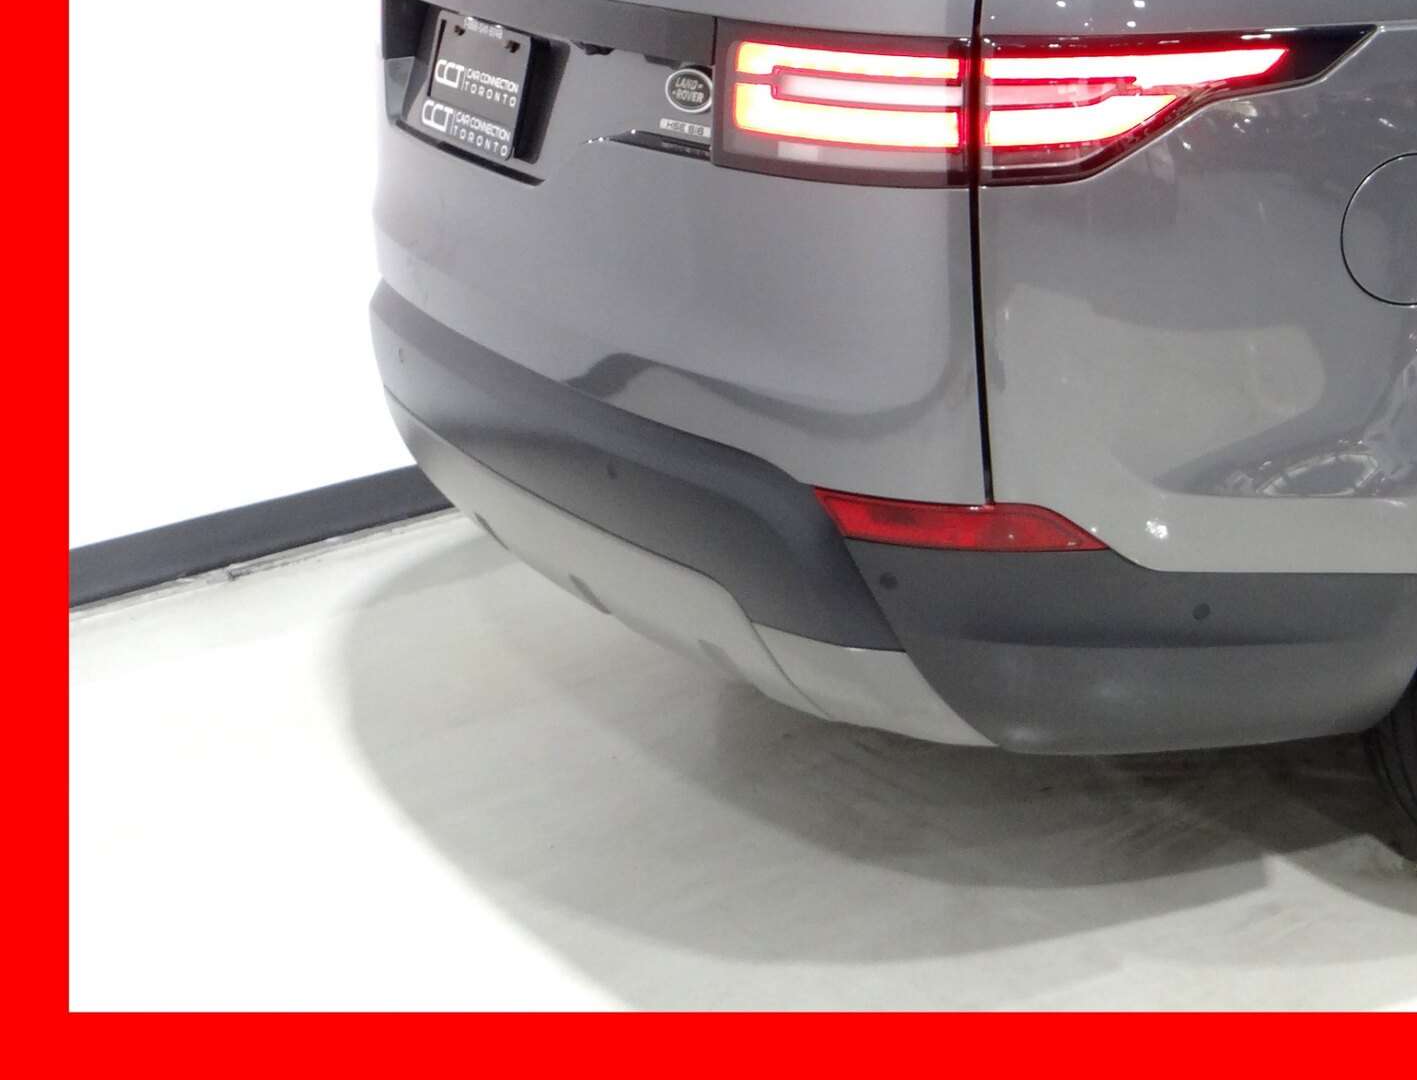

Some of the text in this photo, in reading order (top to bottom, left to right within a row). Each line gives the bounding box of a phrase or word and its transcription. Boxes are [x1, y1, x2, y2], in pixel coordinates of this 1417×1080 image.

[435, 59, 465, 89] CCT
[467, 68, 519, 94] CAR CONNECTION
[464, 81, 517, 108] TORONTO
[422, 99, 454, 132] CCT
[456, 111, 511, 143] CAR CONNECTION
[453, 125, 508, 157] TORONTO
